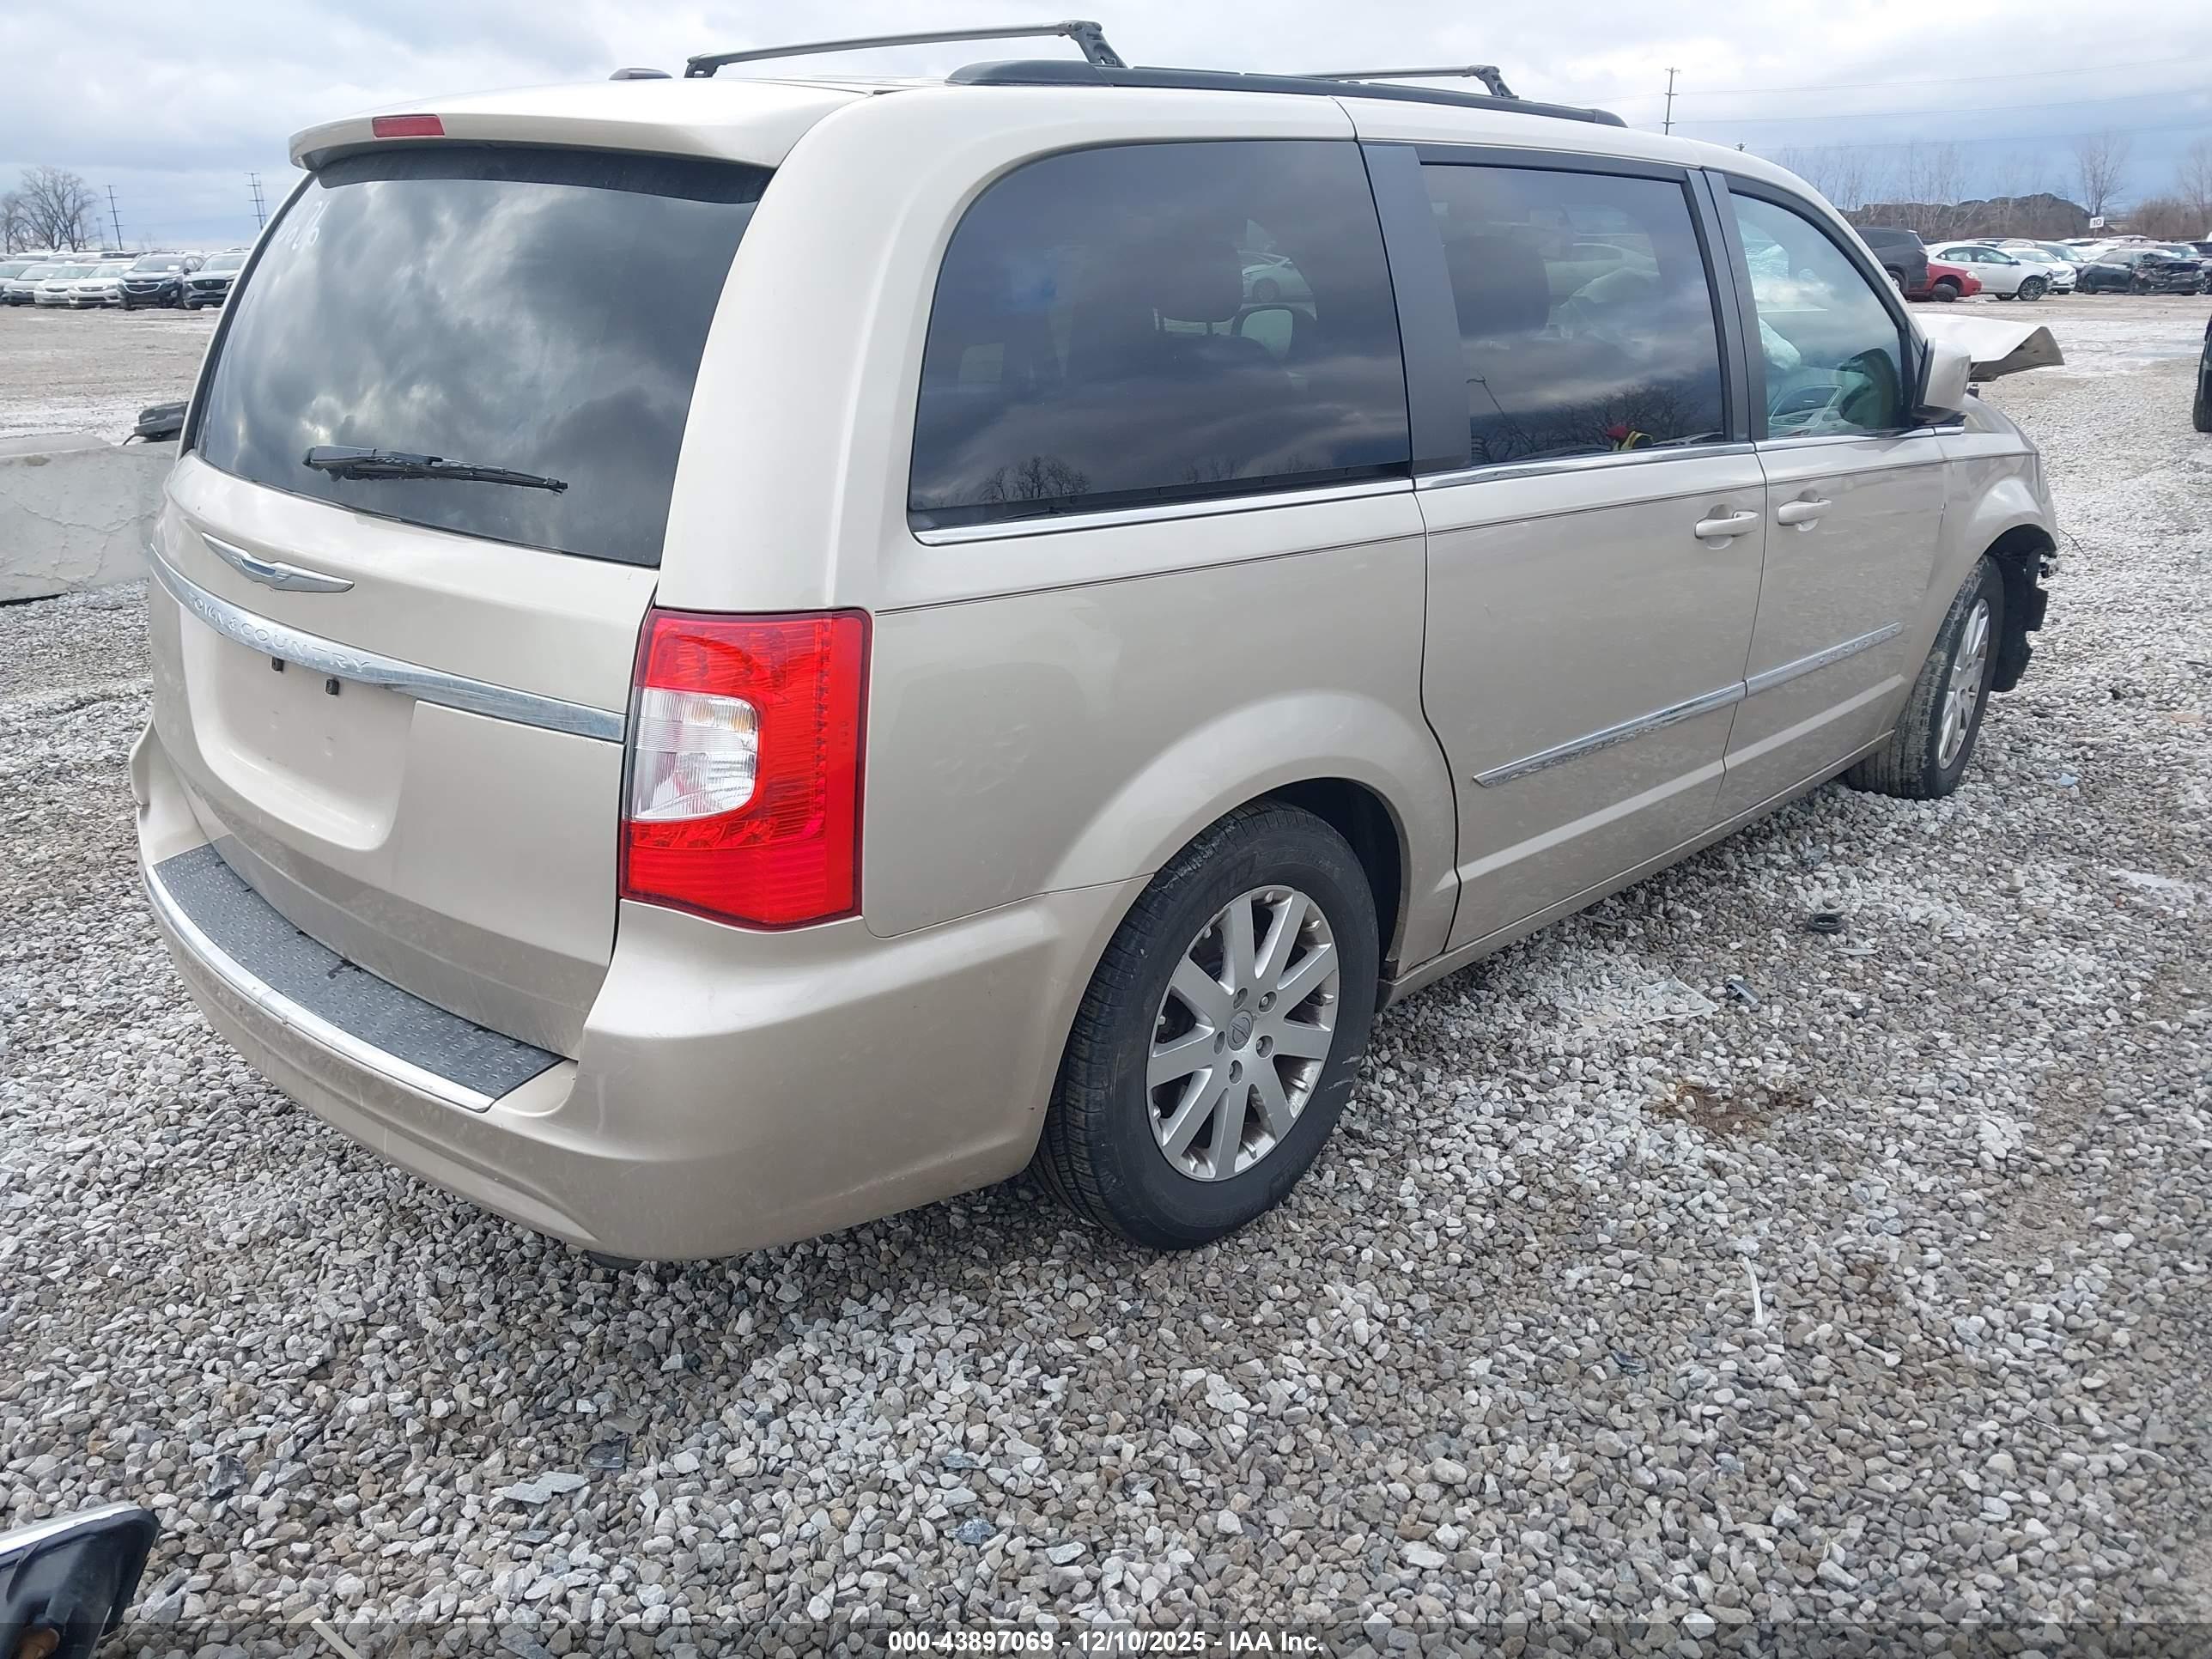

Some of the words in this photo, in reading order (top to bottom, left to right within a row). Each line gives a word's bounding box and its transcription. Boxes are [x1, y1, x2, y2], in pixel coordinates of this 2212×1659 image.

[2093, 218, 2102, 227] 10
[228, 617, 237, 632] &
[240, 623, 372, 673] COUNTRY
